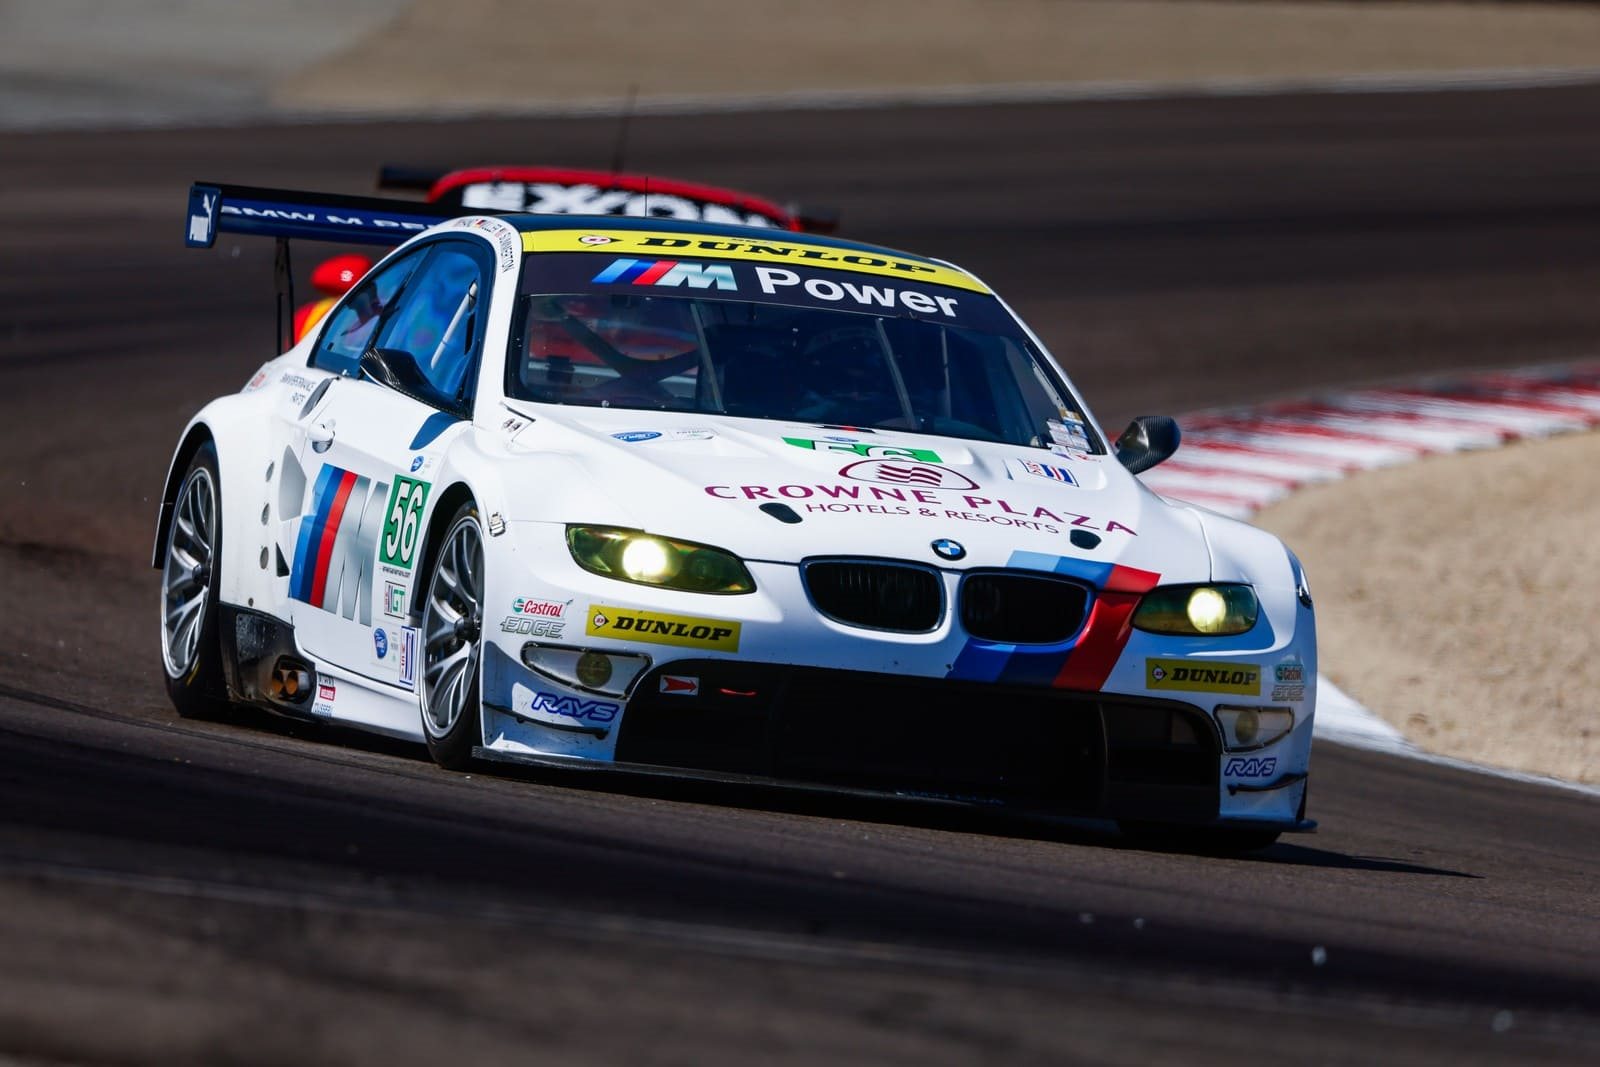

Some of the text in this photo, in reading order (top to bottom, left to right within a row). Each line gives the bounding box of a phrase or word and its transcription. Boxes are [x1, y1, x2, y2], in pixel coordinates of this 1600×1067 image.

[326, 215, 363, 226] M
[636, 236, 938, 274] DUNLOP
[755, 266, 959, 318] Power
[386, 479, 424, 564] 56
[704, 484, 1139, 537] CROWNE PLAZA
[805, 503, 1060, 535] HOTELS & RESORTS
[523, 599, 564, 618] Castrol
[500, 615, 567, 639] EDGE
[612, 615, 733, 641] DUNLOP
[1170, 667, 1257, 686] DUNLOP
[531, 692, 620, 722] RAYS
[1224, 757, 1277, 777] RAYS
